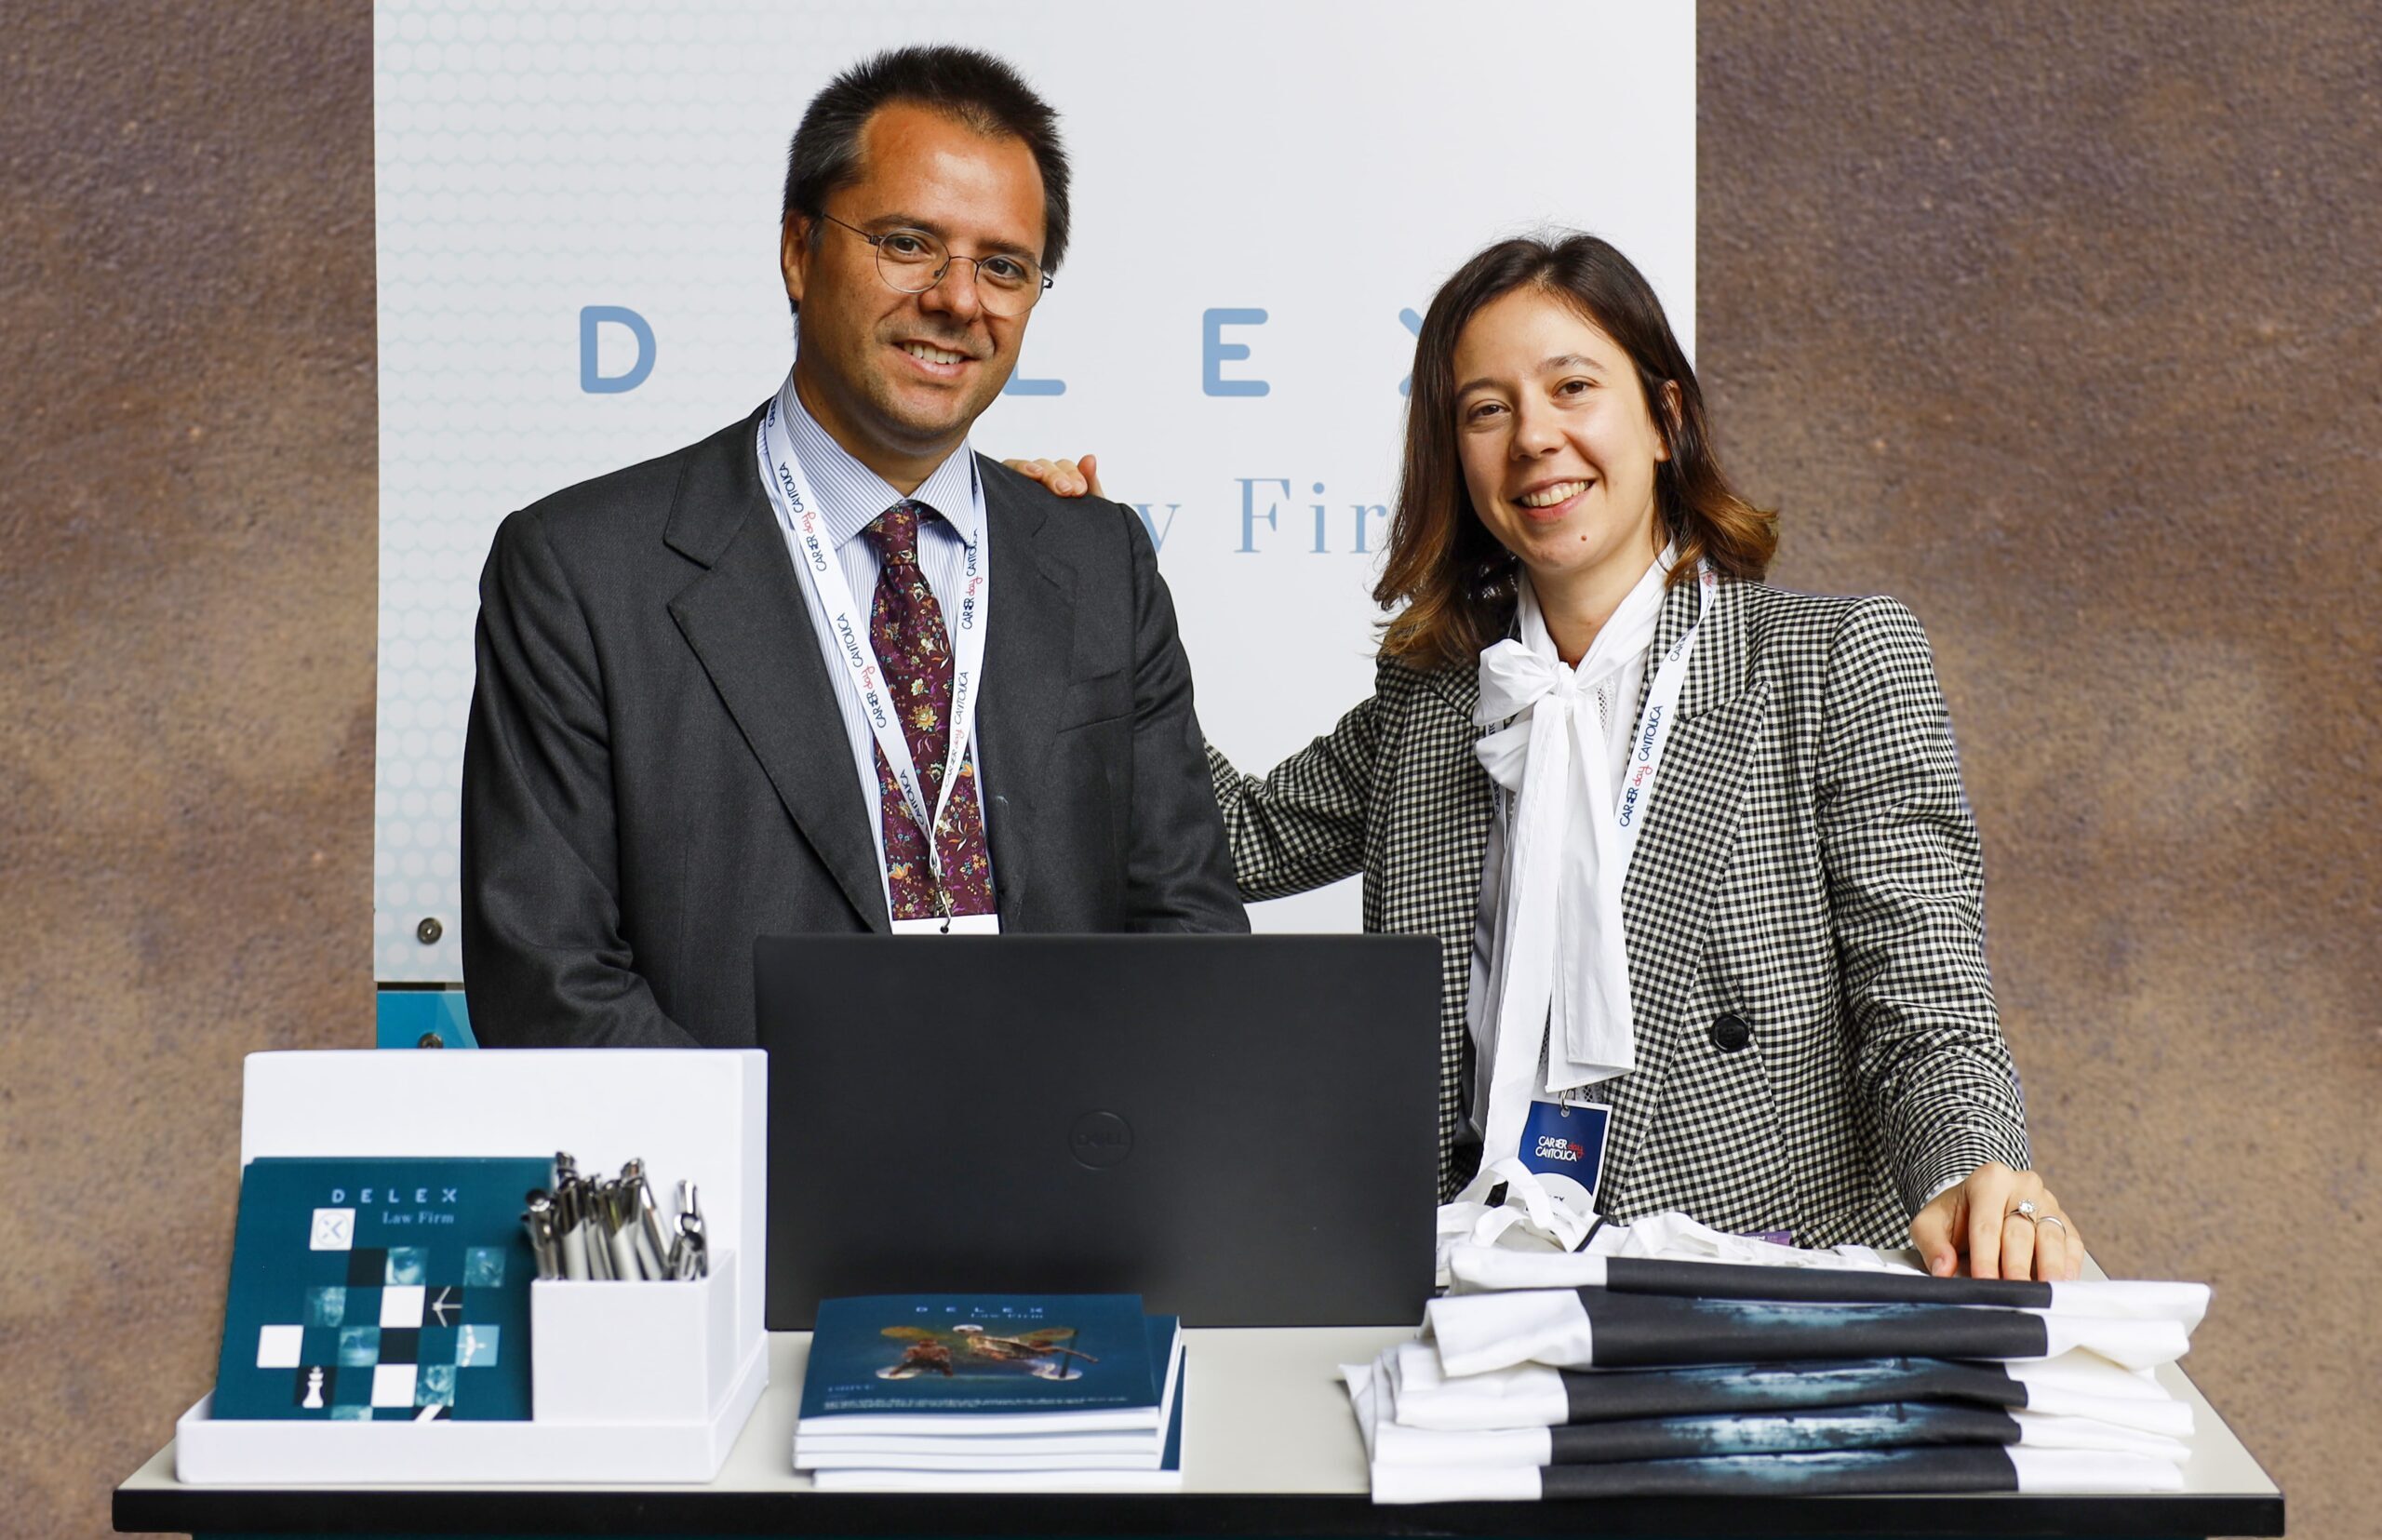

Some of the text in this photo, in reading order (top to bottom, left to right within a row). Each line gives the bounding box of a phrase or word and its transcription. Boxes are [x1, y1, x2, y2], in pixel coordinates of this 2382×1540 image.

[802, 511, 816, 534] day
[1234, 478, 1388, 554] Fir
[969, 577, 983, 596] day
[862, 665, 876, 690] day
[953, 729, 965, 750] day
[1619, 787, 1638, 827] CAREER
[1632, 765, 1653, 786] day
[1538, 1135, 1567, 1149] CAREER
[331, 1188, 457, 1203] DELEX
[382, 1212, 455, 1225] Law Firm
